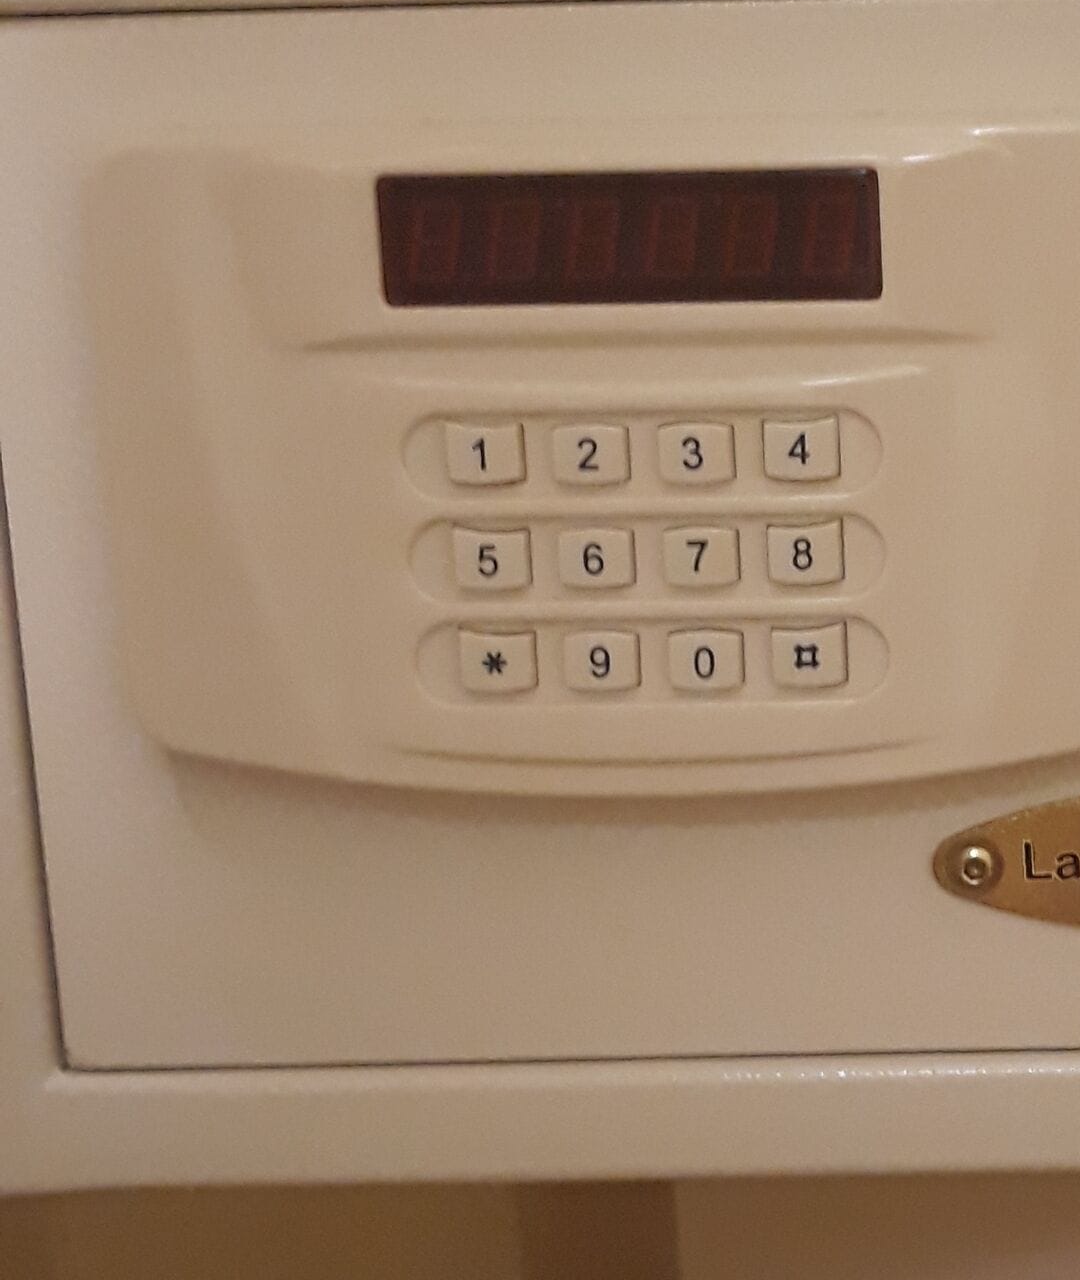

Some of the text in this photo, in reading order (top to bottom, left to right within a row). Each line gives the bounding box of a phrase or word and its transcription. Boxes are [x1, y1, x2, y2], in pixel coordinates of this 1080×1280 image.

[471, 434, 810, 471] 1 2 3 4
[478, 538, 813, 578] 5 6 7 8
[589, 645, 611, 679] 9
[693, 646, 715, 679] 0
